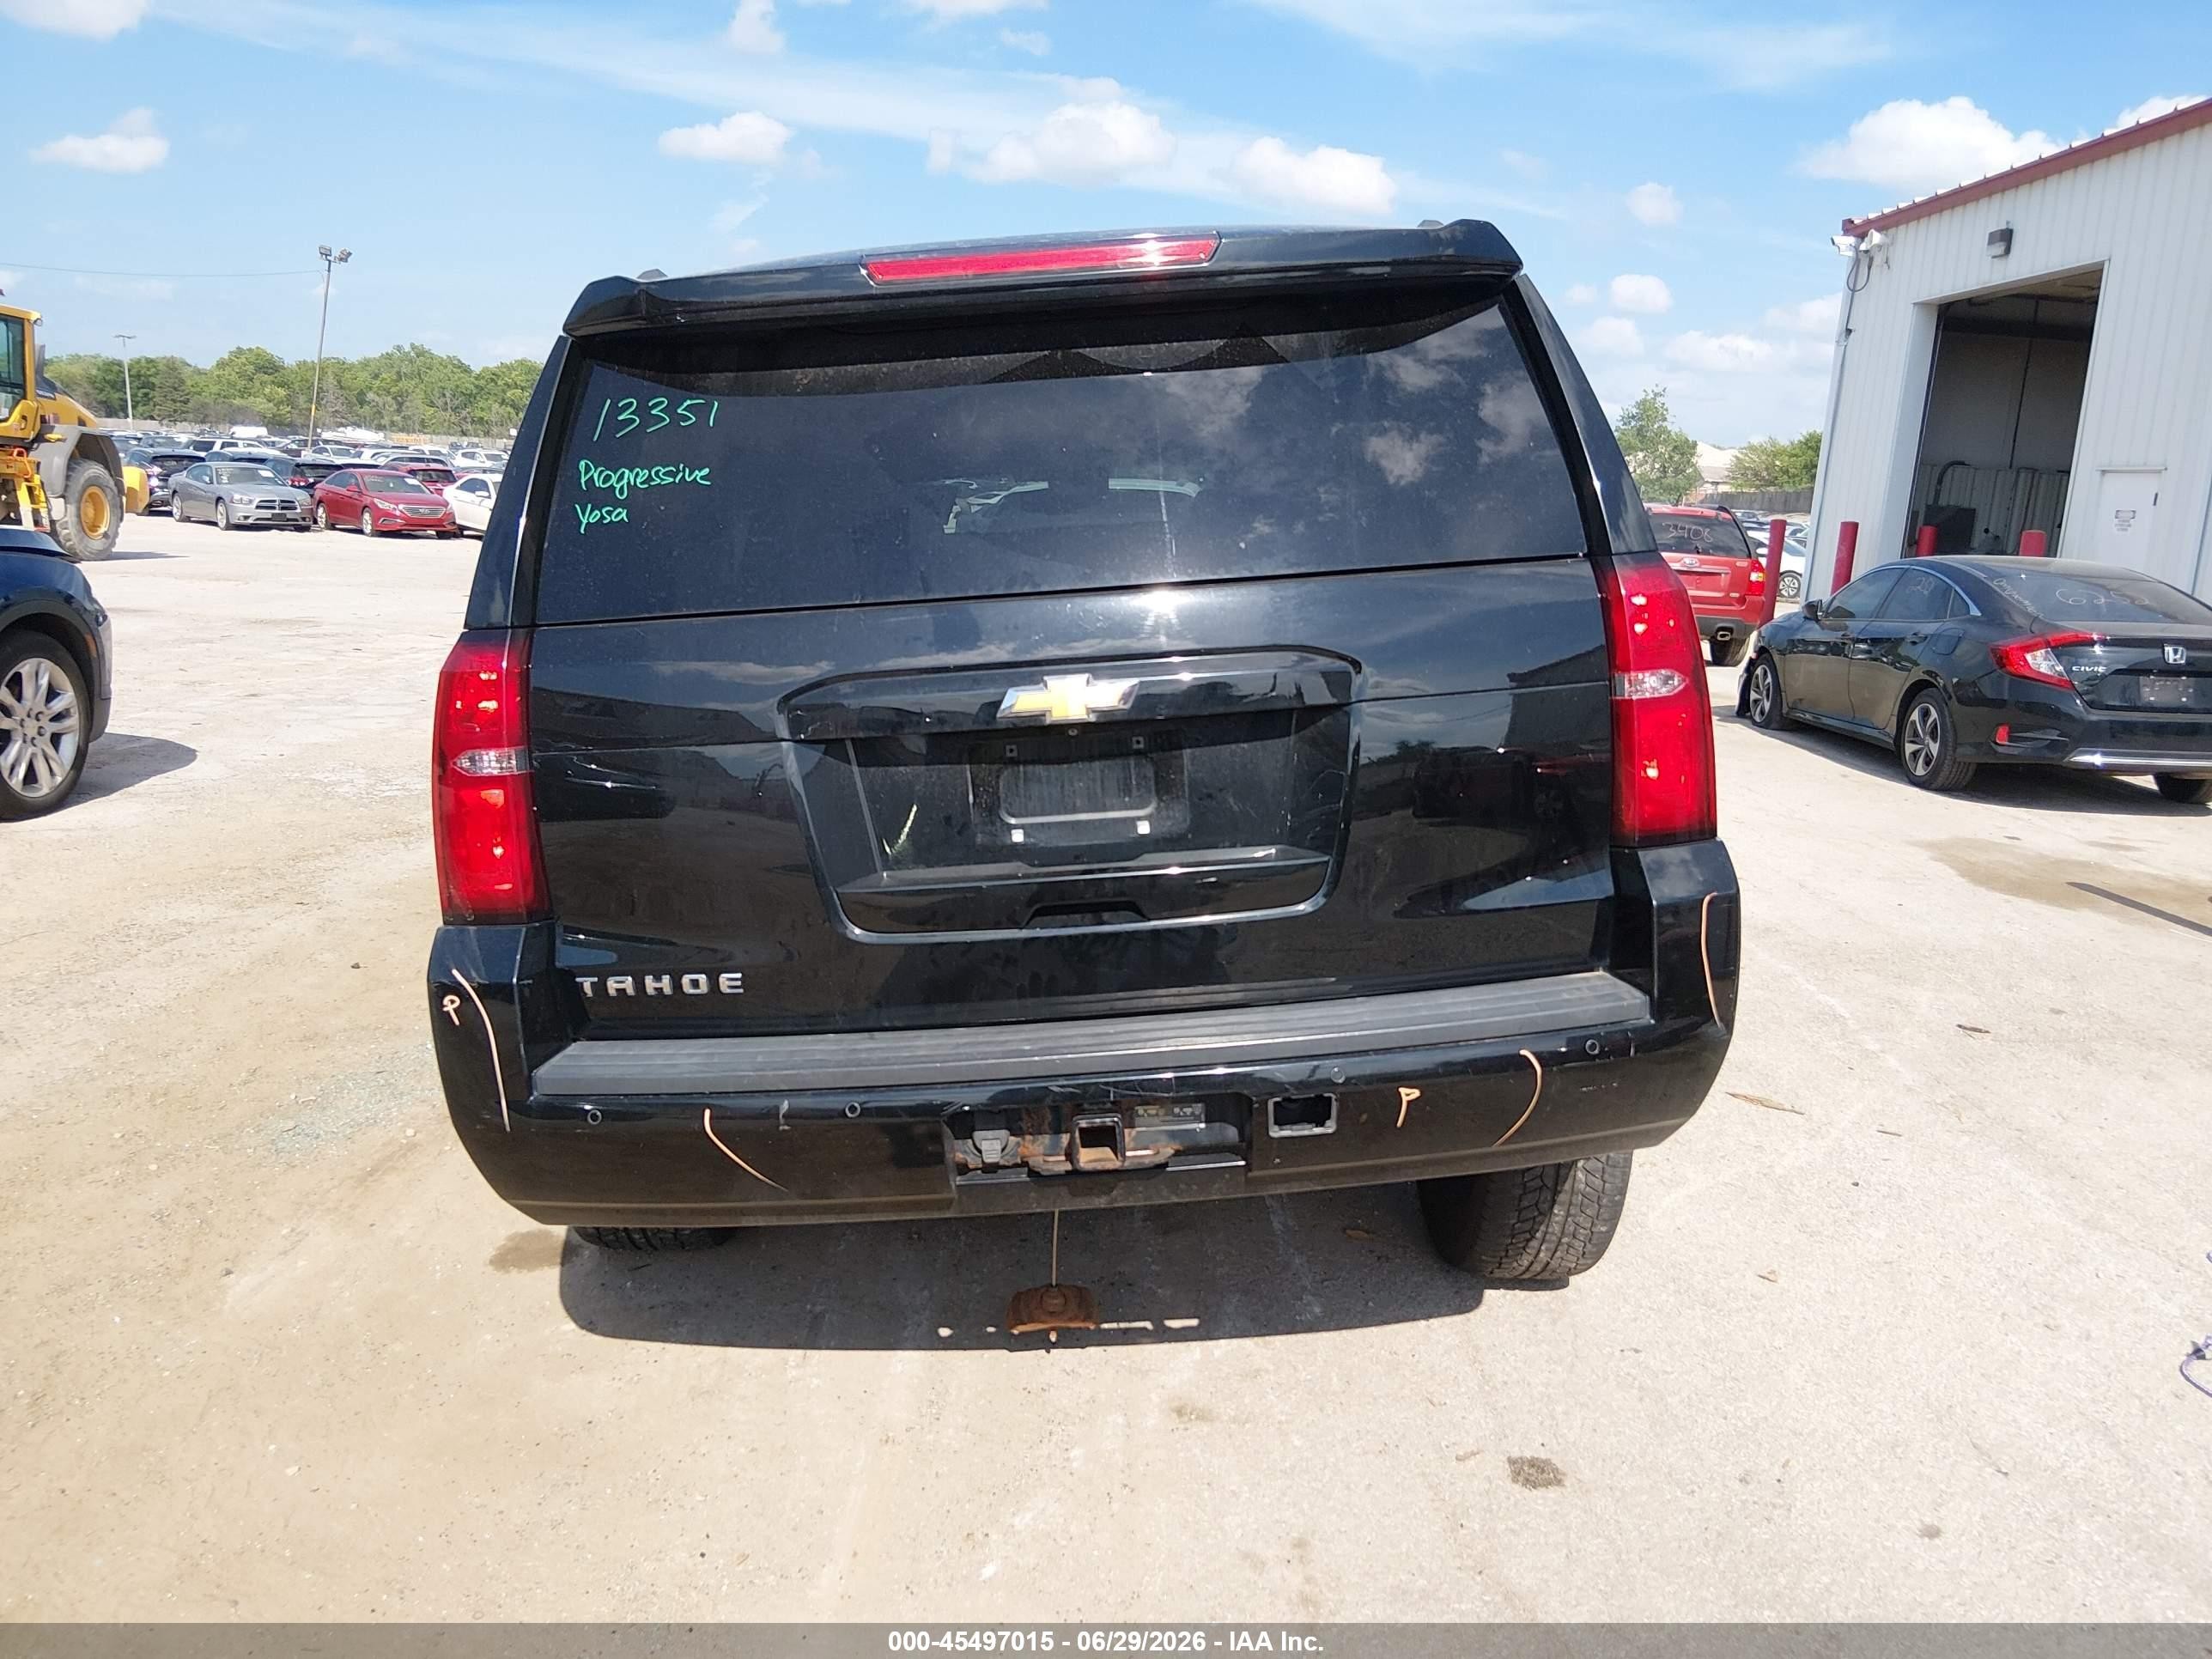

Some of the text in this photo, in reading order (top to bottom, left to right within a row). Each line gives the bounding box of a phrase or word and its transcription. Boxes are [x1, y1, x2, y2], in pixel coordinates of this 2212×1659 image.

[592, 397, 720, 441] 13351
[578, 459, 712, 500] Progressive
[1662, 520, 1714, 543] 3408
[575, 972, 745, 998] TAHOE
